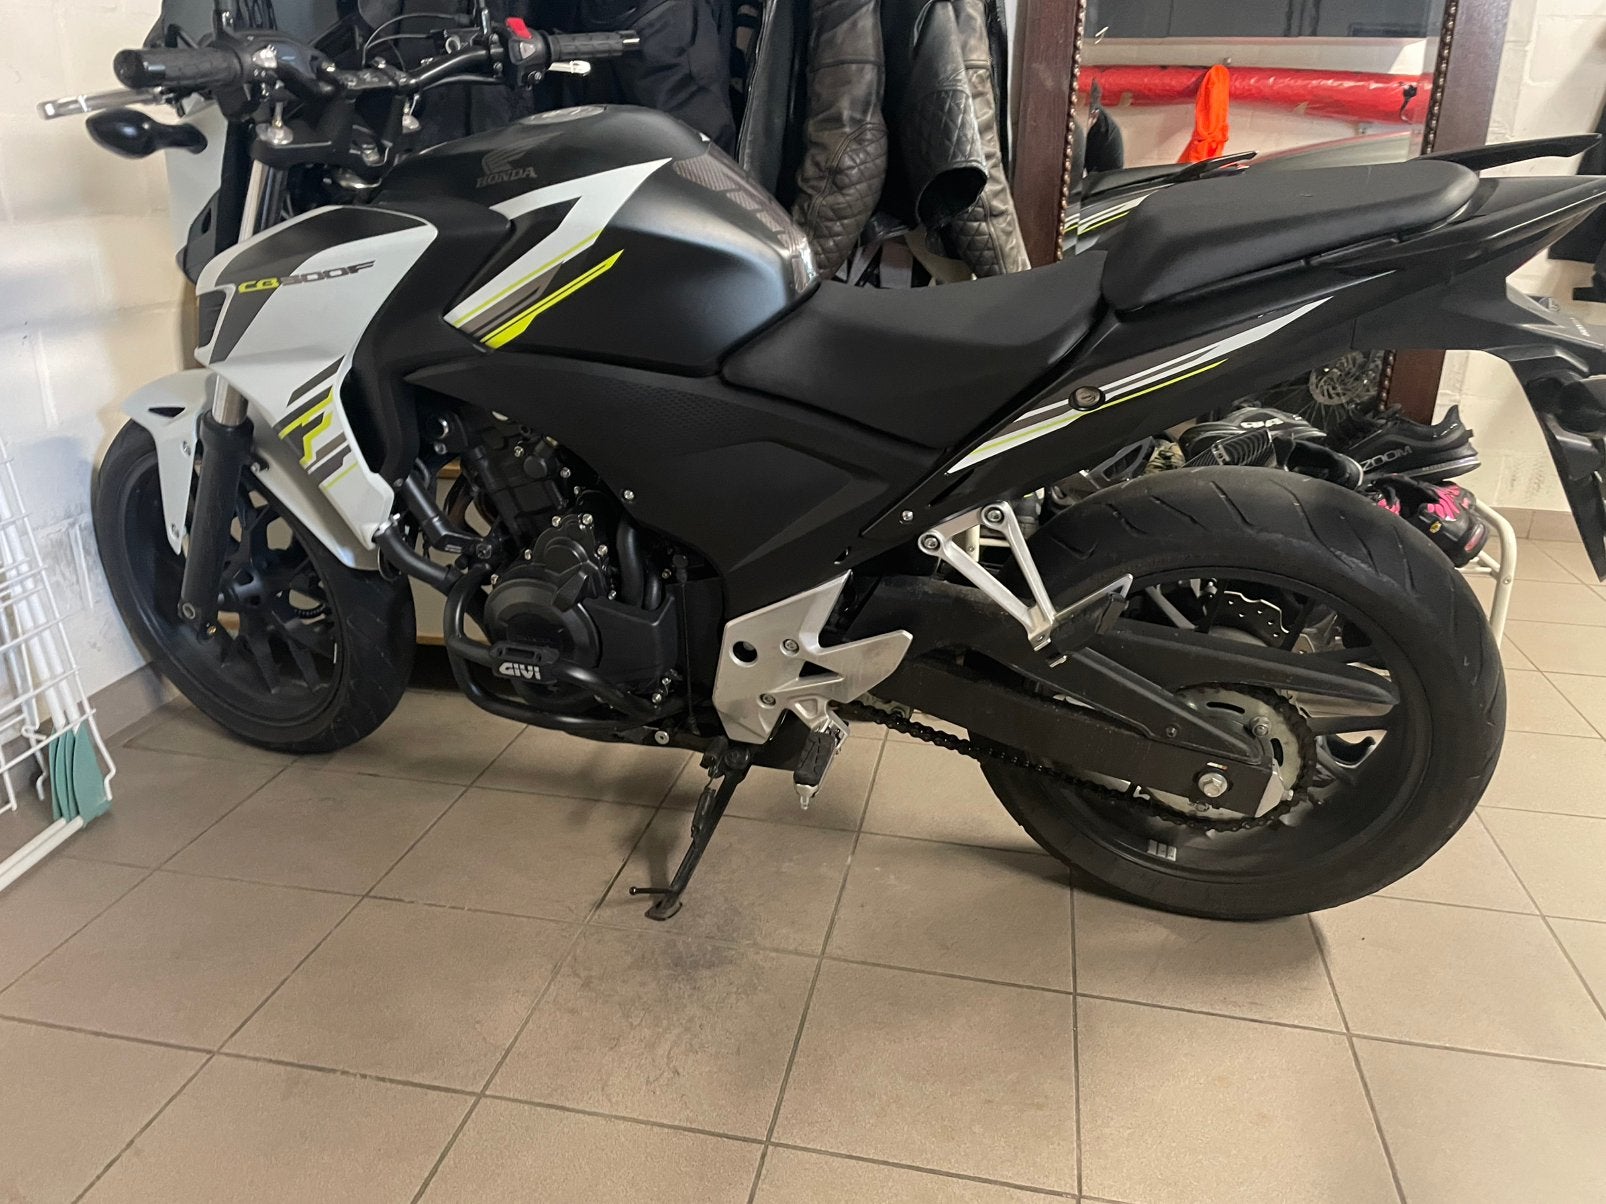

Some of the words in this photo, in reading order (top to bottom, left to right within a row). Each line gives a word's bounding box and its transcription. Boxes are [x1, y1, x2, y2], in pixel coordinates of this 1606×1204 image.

[475, 166, 538, 188] HONDA
[1360, 445, 1413, 472] ZOOM
[499, 661, 541, 680] GIVI
